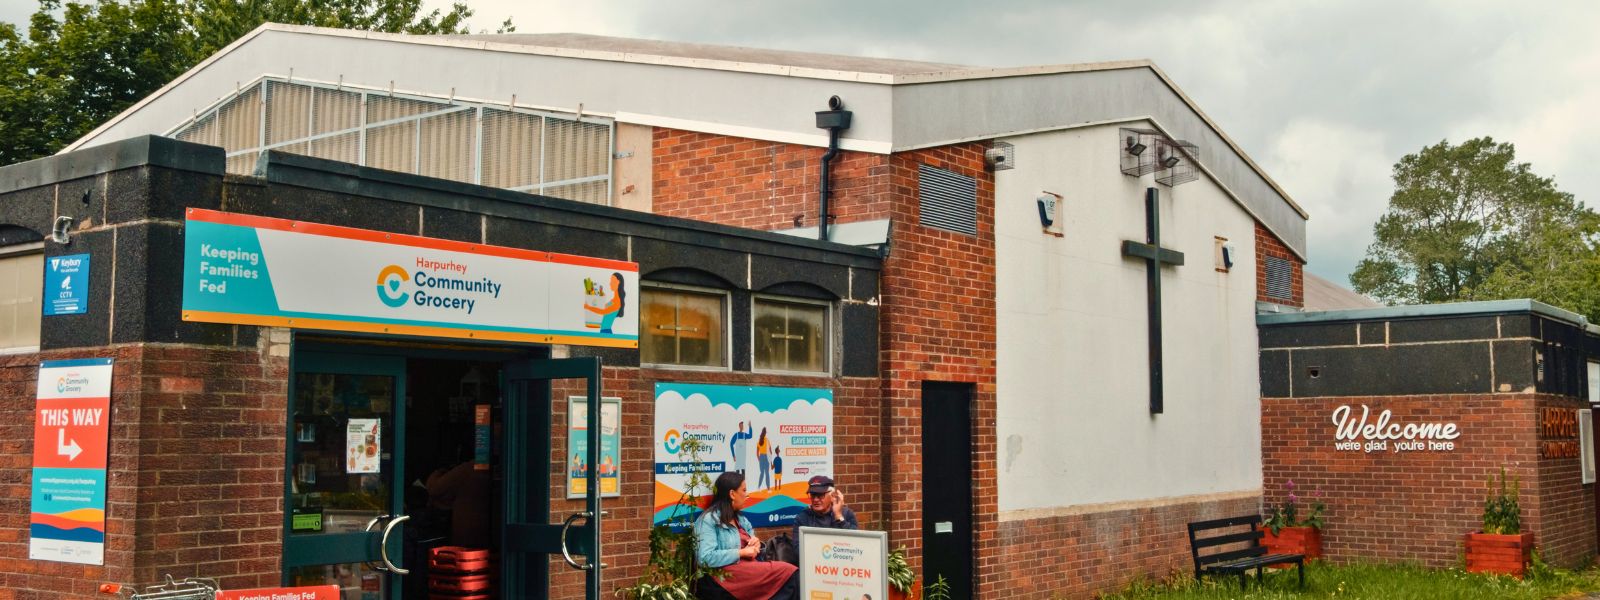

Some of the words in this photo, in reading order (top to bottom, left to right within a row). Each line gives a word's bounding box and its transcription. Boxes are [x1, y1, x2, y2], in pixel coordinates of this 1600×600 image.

[201, 244, 259, 266] Keeping
[200, 261, 258, 280] Families
[416, 257, 467, 275] Harpurhey
[200, 279, 226, 294] Fed
[414, 271, 501, 298] Community
[413, 290, 475, 314] Grocery
[40, 408, 69, 426] THIS
[72, 408, 102, 426] WAY
[1331, 404, 1460, 440] Welcome
[683, 431, 726, 443] Community
[1364, 440, 1387, 453] glad
[1429, 440, 1454, 450] here
[711, 463, 722, 471] Fed
[833, 546, 863, 555] Community
[815, 566, 838, 575] NOW
[842, 567, 871, 578] OPEN
[301, 592, 316, 600] Fed
